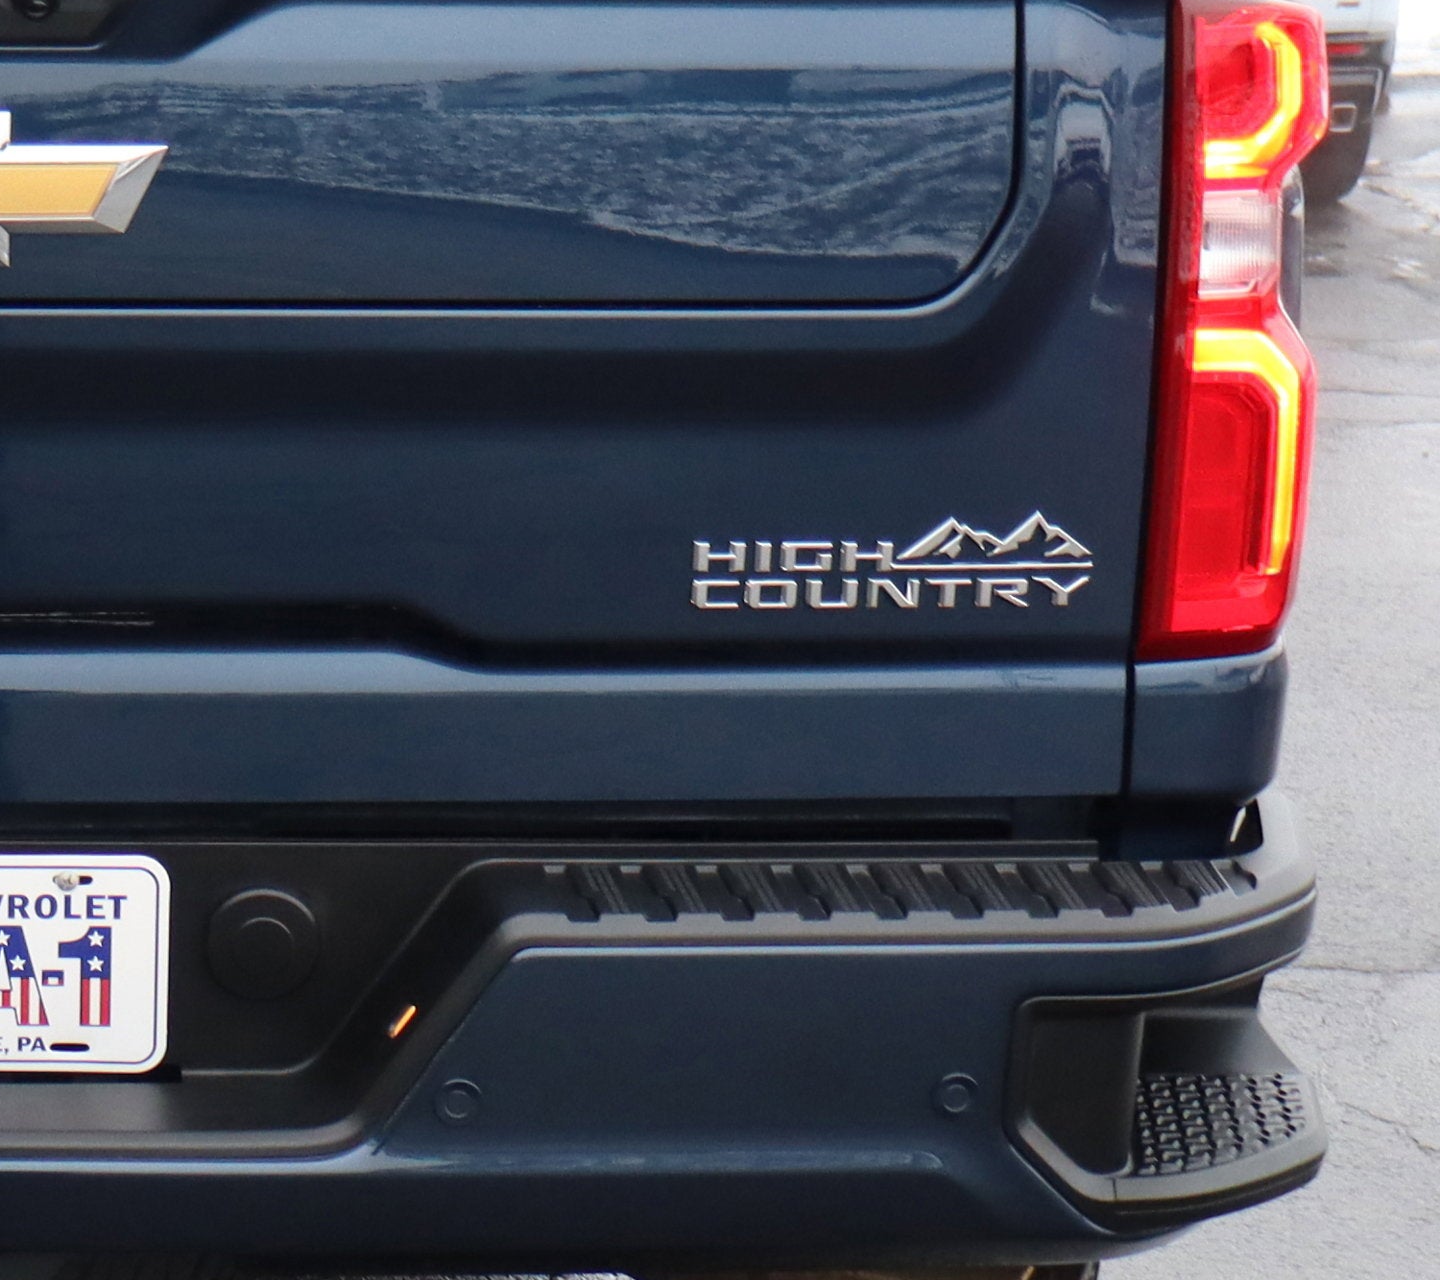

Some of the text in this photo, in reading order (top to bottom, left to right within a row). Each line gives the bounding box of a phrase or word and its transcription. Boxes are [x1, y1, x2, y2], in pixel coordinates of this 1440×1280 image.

[692, 540, 895, 572] HIGH
[689, 575, 1091, 608] COUNTRY
[17, 1036, 47, 1053] PA
